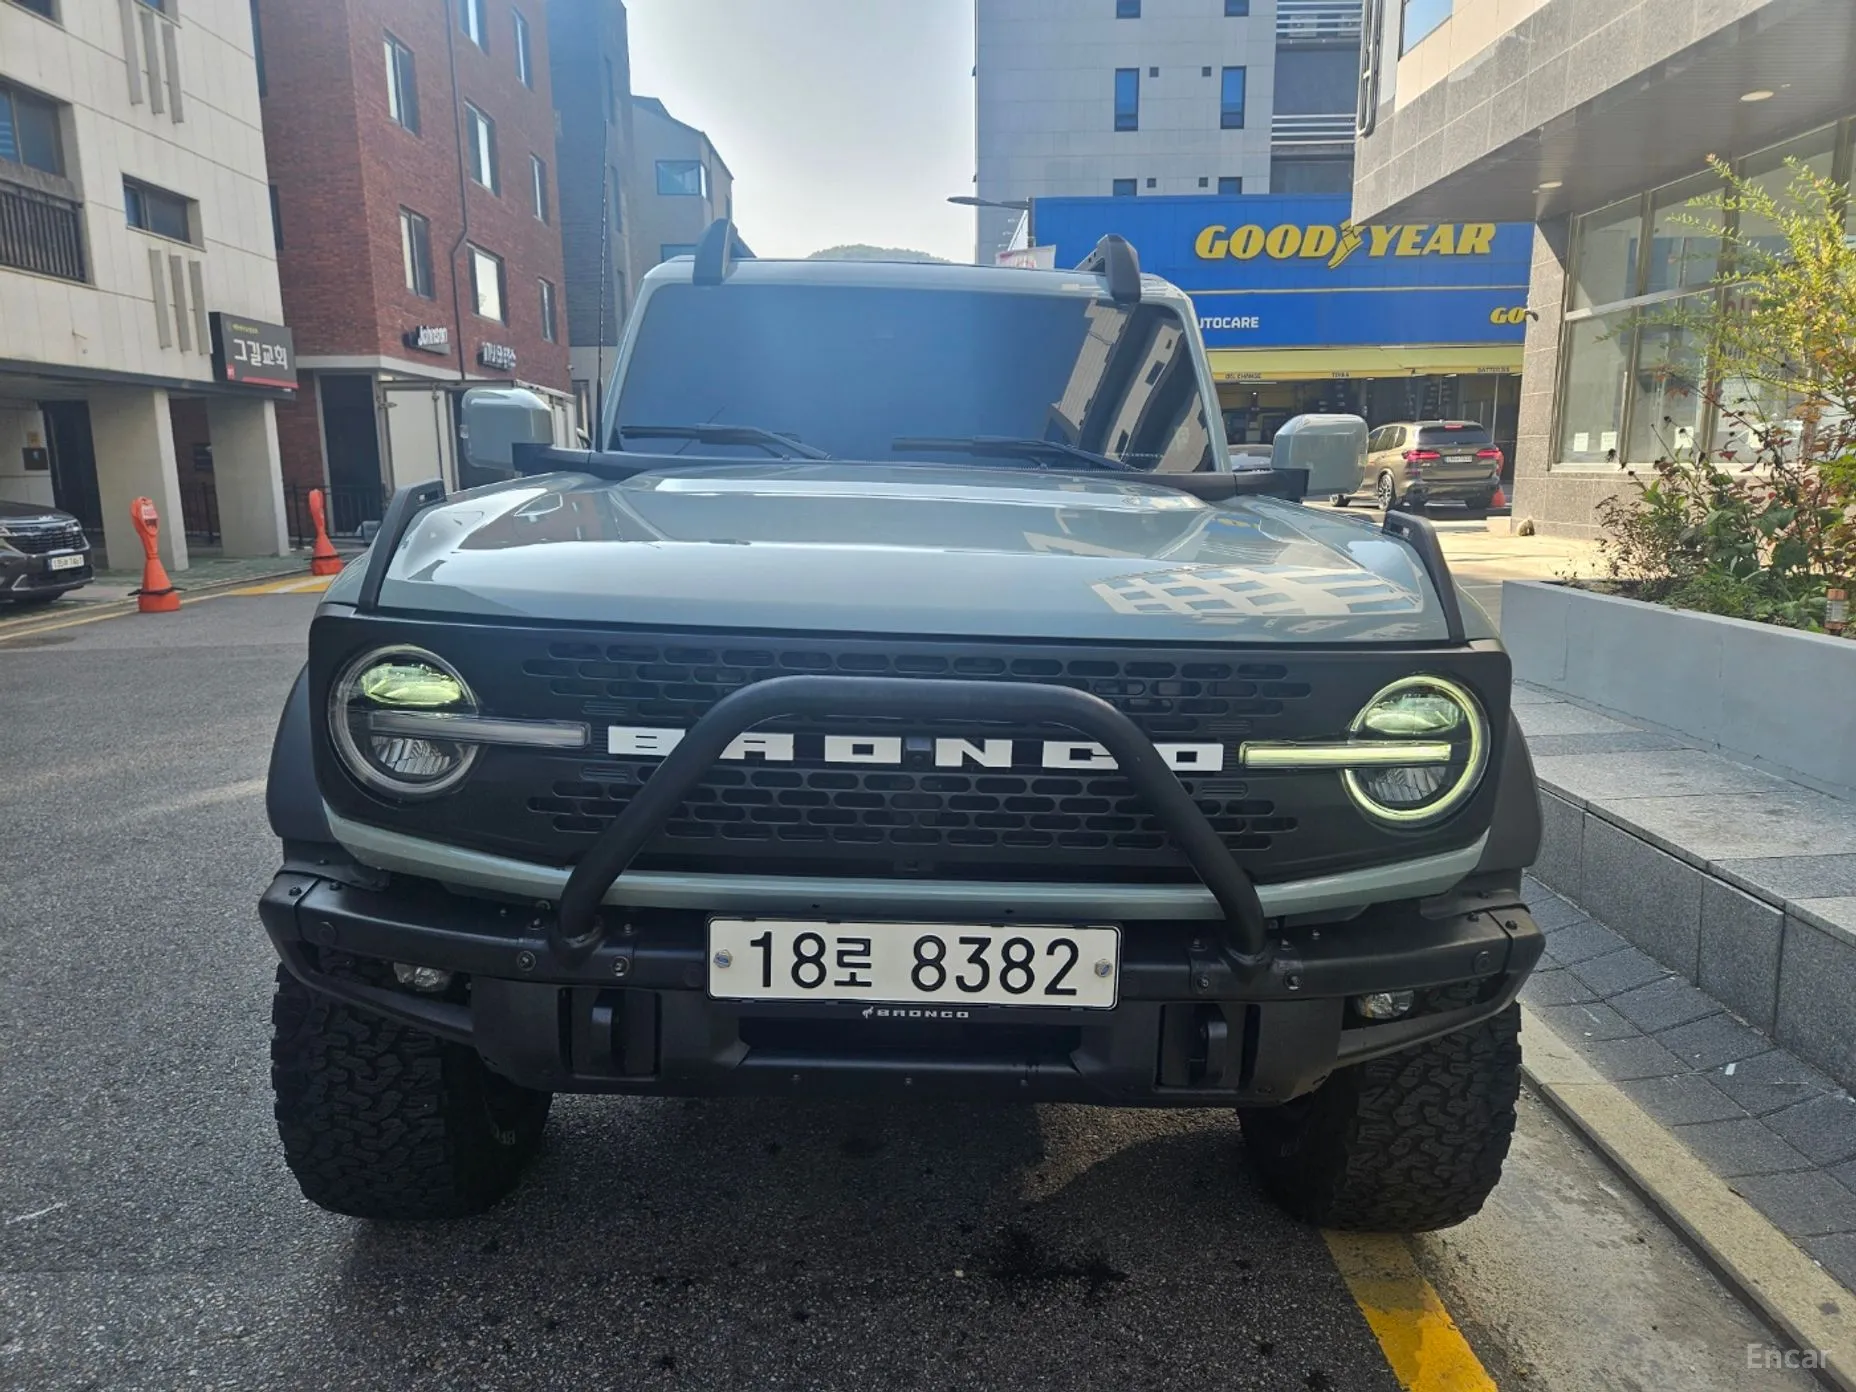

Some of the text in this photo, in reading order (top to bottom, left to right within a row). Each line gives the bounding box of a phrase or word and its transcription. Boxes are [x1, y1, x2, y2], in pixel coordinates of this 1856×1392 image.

[233, 338, 288, 370] 그길교회
[608, 725, 1223, 772] BRONCO
[750, 931, 1080, 996] 18로 8382
[877, 1009, 969, 1019] BRONCO
